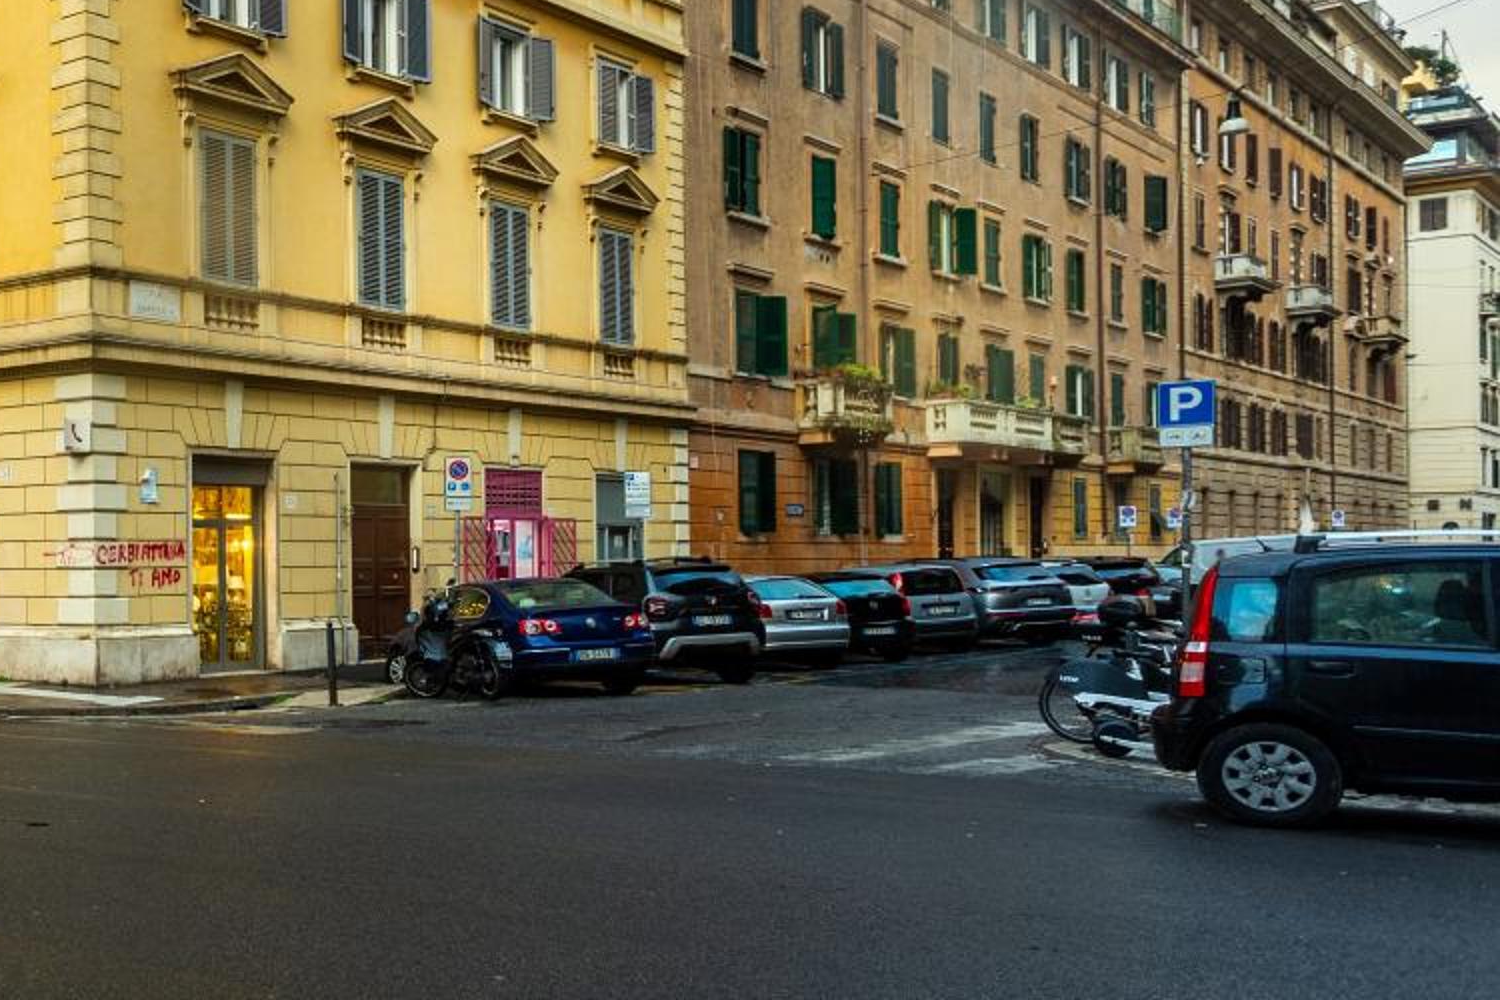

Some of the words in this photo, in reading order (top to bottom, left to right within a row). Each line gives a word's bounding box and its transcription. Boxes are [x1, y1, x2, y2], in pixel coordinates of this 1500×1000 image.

[1169, 386, 1203, 422] P
[129, 568, 143, 587] TI
[151, 568, 181, 589] AMO
